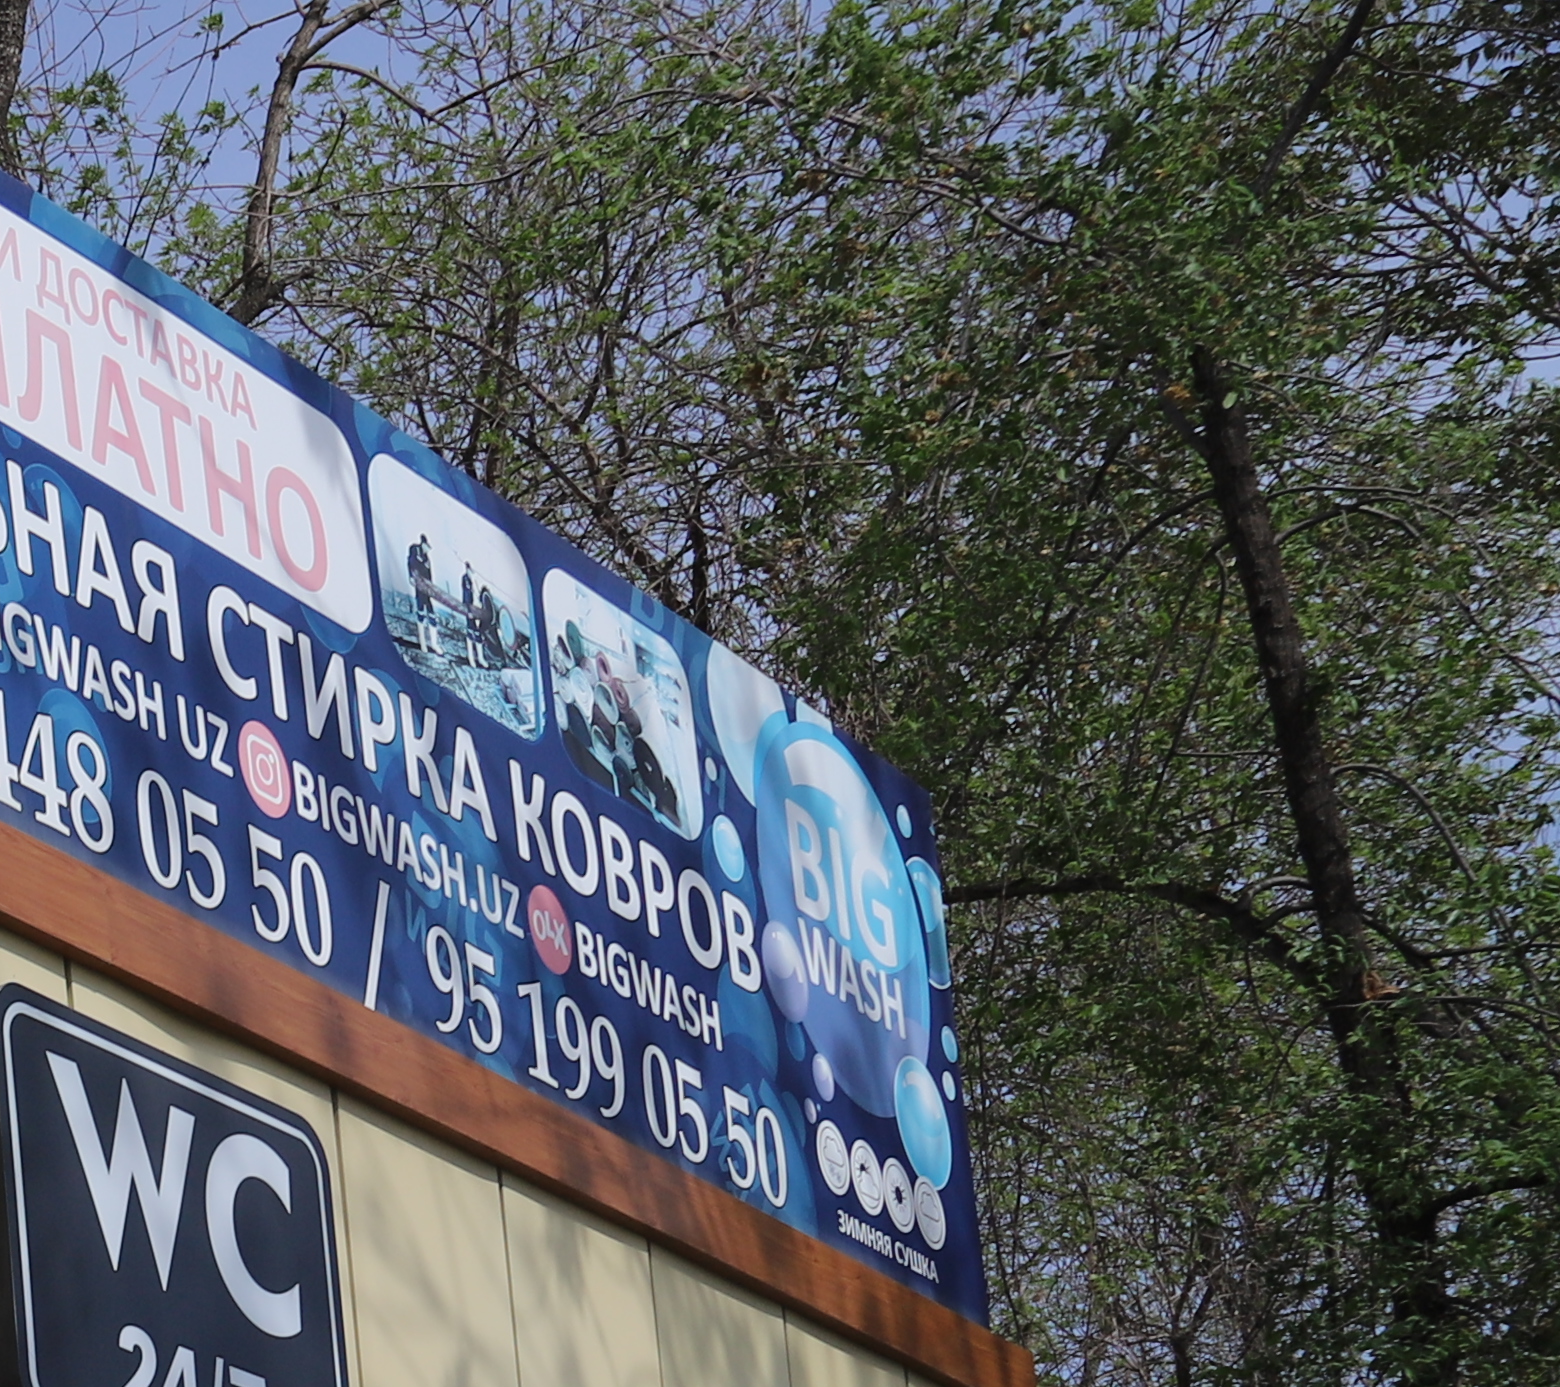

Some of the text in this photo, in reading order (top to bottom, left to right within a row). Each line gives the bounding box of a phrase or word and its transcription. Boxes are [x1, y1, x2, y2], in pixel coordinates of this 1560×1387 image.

[37, 243, 258, 432] ДОСТАВКА
[177, 693, 235, 778] UZ
[206, 584, 500, 843] СТИРКА
[507, 757, 763, 993] КОВРОВ
[292, 759, 526, 940] BIGWASH.UZ
[782, 796, 899, 969] BIG
[136, 768, 228, 911] 05
[246, 822, 335, 968] 50
[424, 924, 504, 1056] 95
[515, 980, 626, 1120] 199
[639, 1042, 710, 1165] 05
[721, 1083, 789, 1210] 50
[574, 921, 724, 1052] BIGWASH
[796, 916, 908, 1042] WASH
[44, 1049, 303, 1339] WC
[836, 1208, 940, 1284] ЗИМНЯЯ СУШКА
